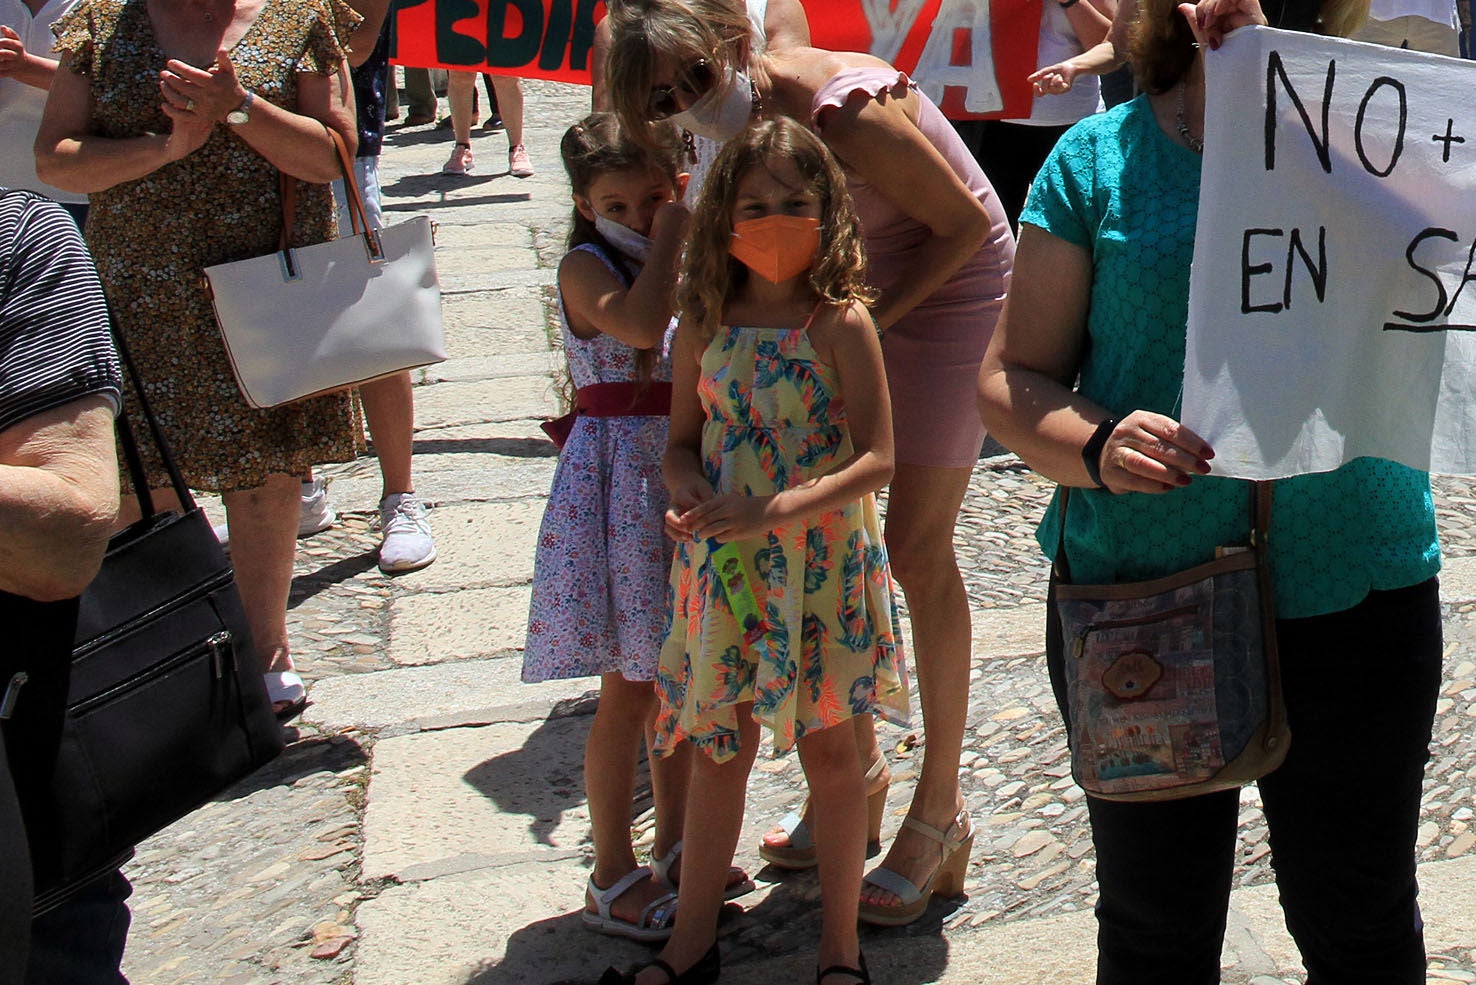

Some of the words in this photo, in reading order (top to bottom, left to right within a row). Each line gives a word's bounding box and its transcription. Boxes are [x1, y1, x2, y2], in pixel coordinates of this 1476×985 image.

[1264, 51, 1407, 178] NO
[1432, 118, 1465, 163] +
[1241, 226, 1328, 315] EN
